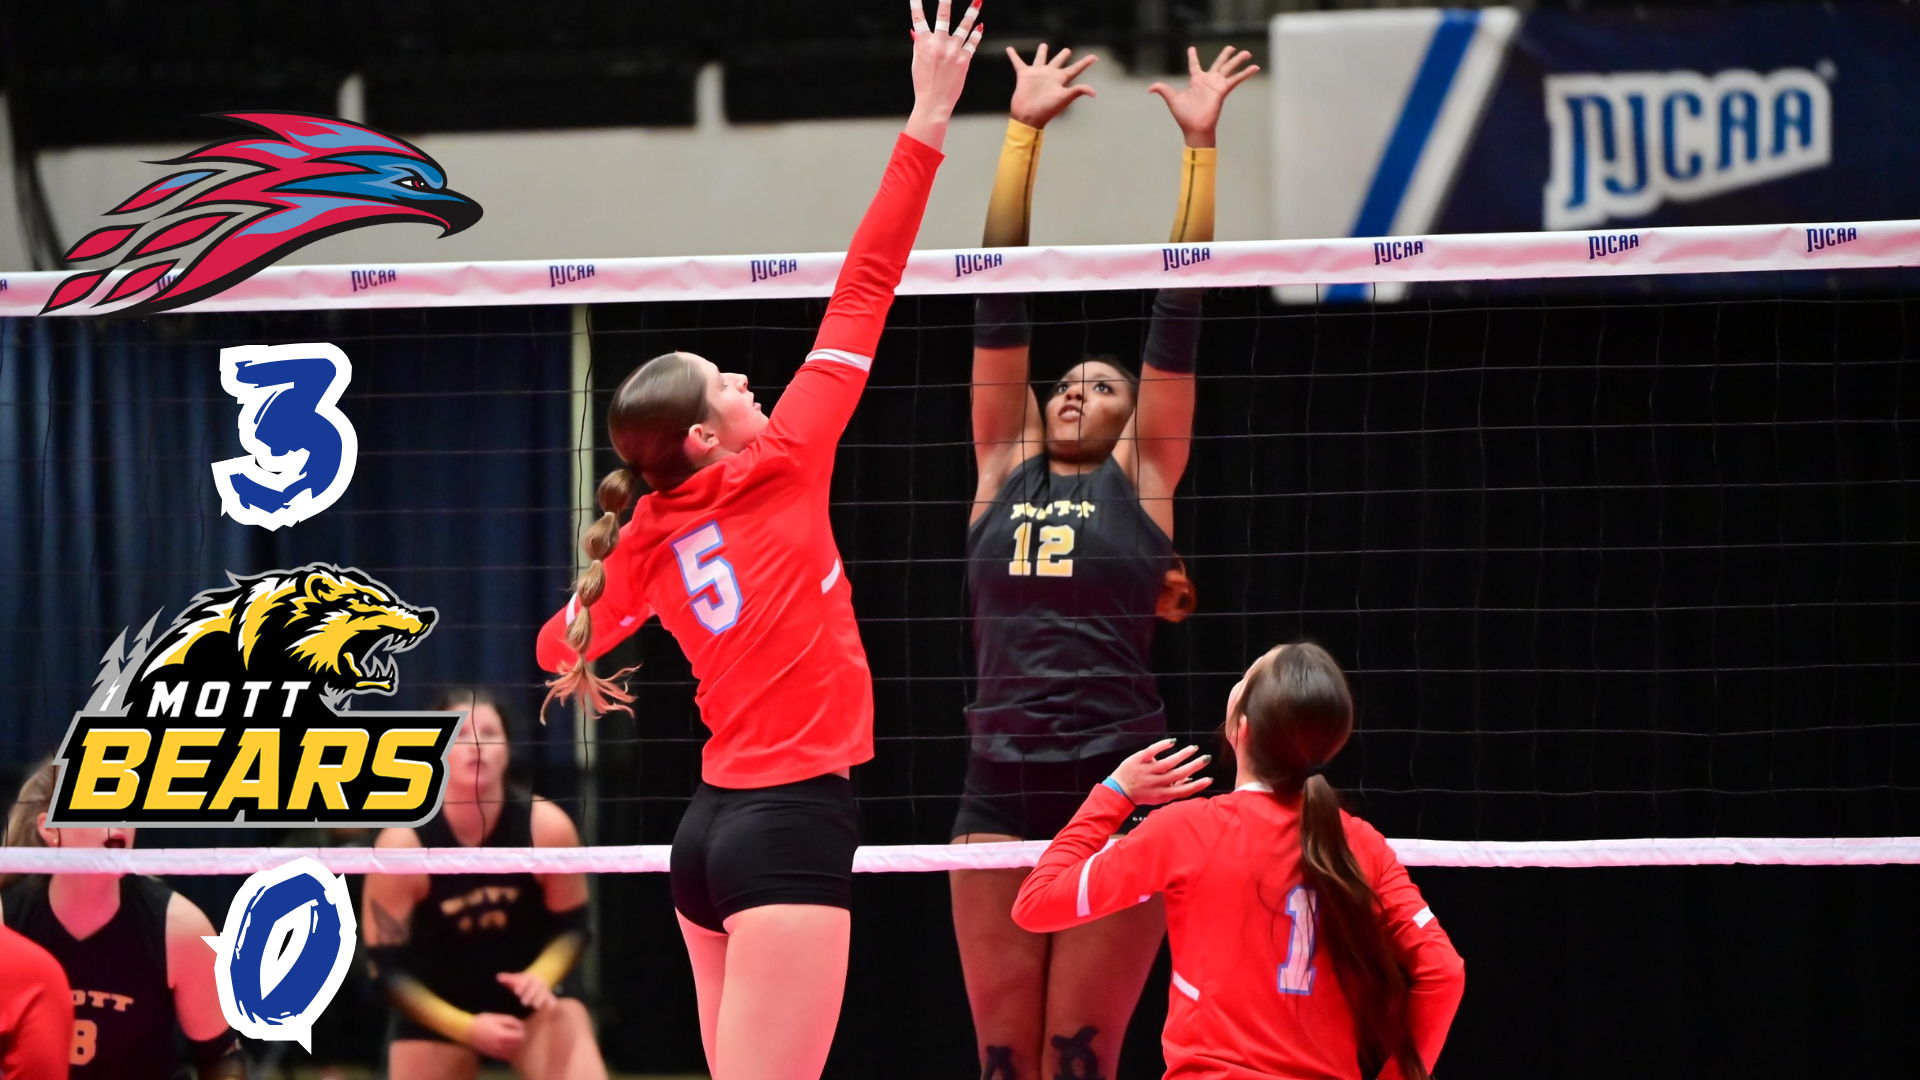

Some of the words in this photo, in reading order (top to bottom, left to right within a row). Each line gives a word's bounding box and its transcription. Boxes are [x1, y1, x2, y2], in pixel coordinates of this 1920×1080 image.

[1565, 89, 1812, 208] NJCAA
[1374, 240, 1423, 265] NJCAA
[1588, 234, 1638, 259] NJCAA
[1806, 228, 1857, 252] NJCAA
[751, 258, 798, 282] NJCAA
[955, 252, 1002, 277] NJCAA
[1163, 247, 1210, 271] NJCAA
[350, 269, 397, 292] NJCAA
[549, 263, 595, 287] NJCAA
[1008, 522, 1075, 577] 12
[670, 519, 743, 635] 5
[1277, 884, 1317, 995] 1
[71, 990, 134, 1012] OTT
